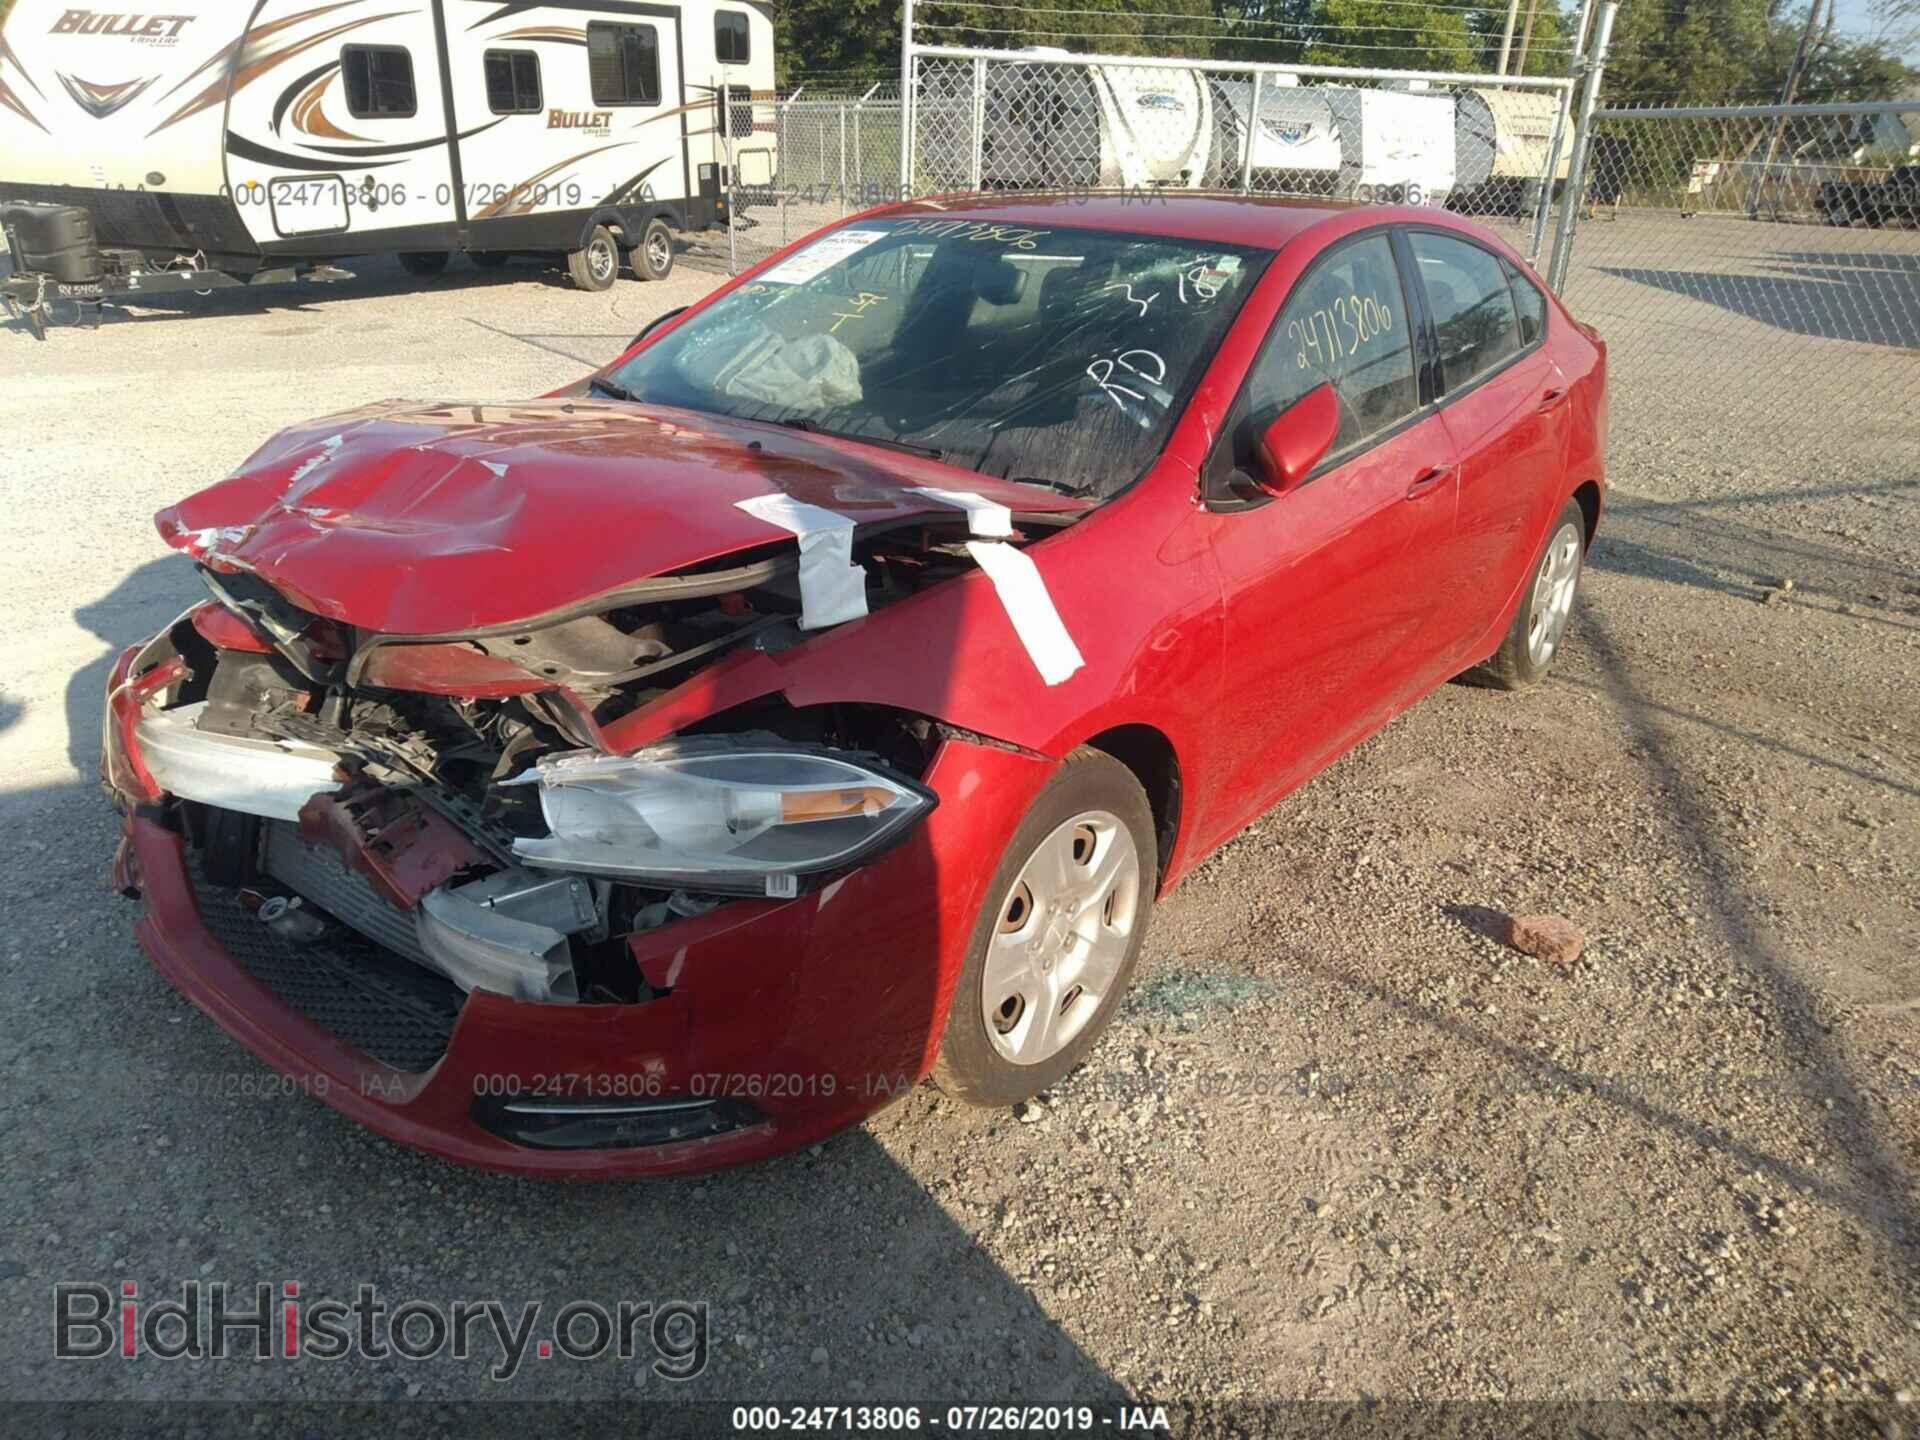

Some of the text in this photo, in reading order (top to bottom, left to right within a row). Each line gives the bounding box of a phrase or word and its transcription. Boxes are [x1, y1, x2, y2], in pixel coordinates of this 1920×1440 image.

[47, 9, 197, 36] BULLET
[547, 109, 613, 129] BULLET
[1288, 289, 1392, 369] 24713806
